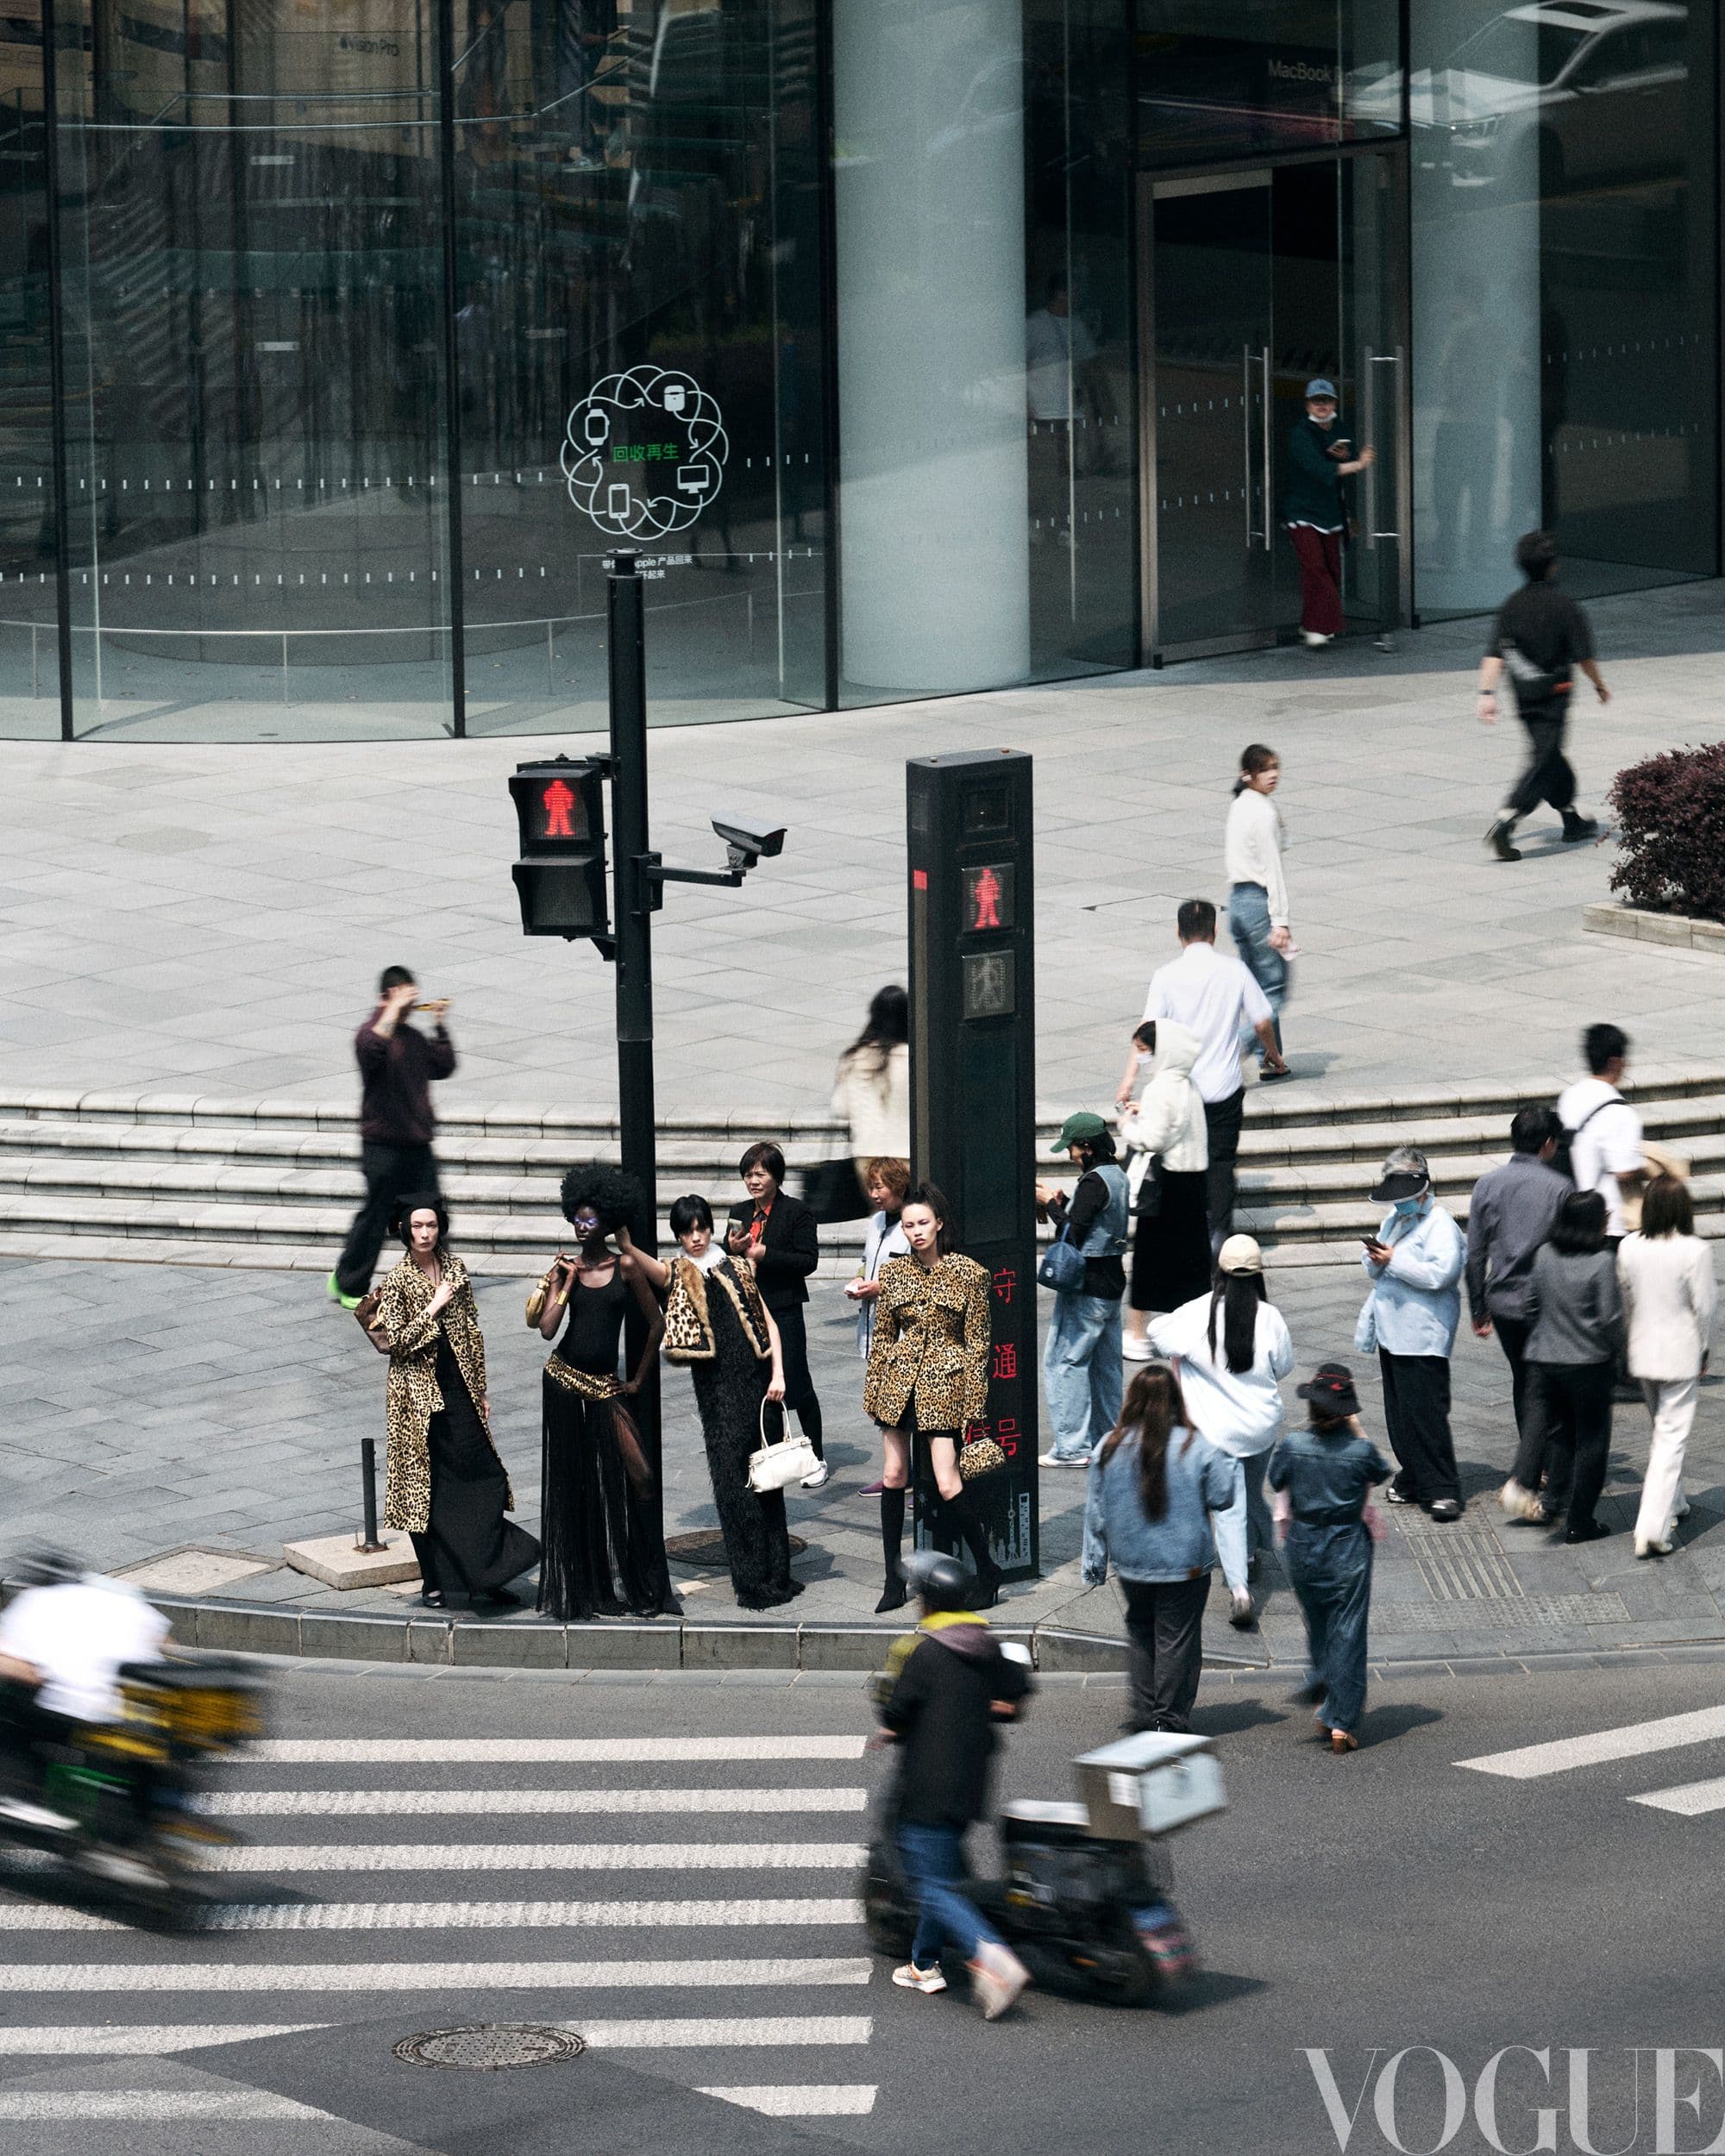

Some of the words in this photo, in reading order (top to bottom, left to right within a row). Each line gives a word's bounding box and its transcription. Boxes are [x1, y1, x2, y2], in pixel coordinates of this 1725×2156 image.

[1269, 60, 1332, 82] MacBook
[612, 443, 680, 463] 回收再生
[635, 557, 656, 569] pple
[993, 1267, 1018, 1304] 守
[993, 1343, 1018, 1380] 通
